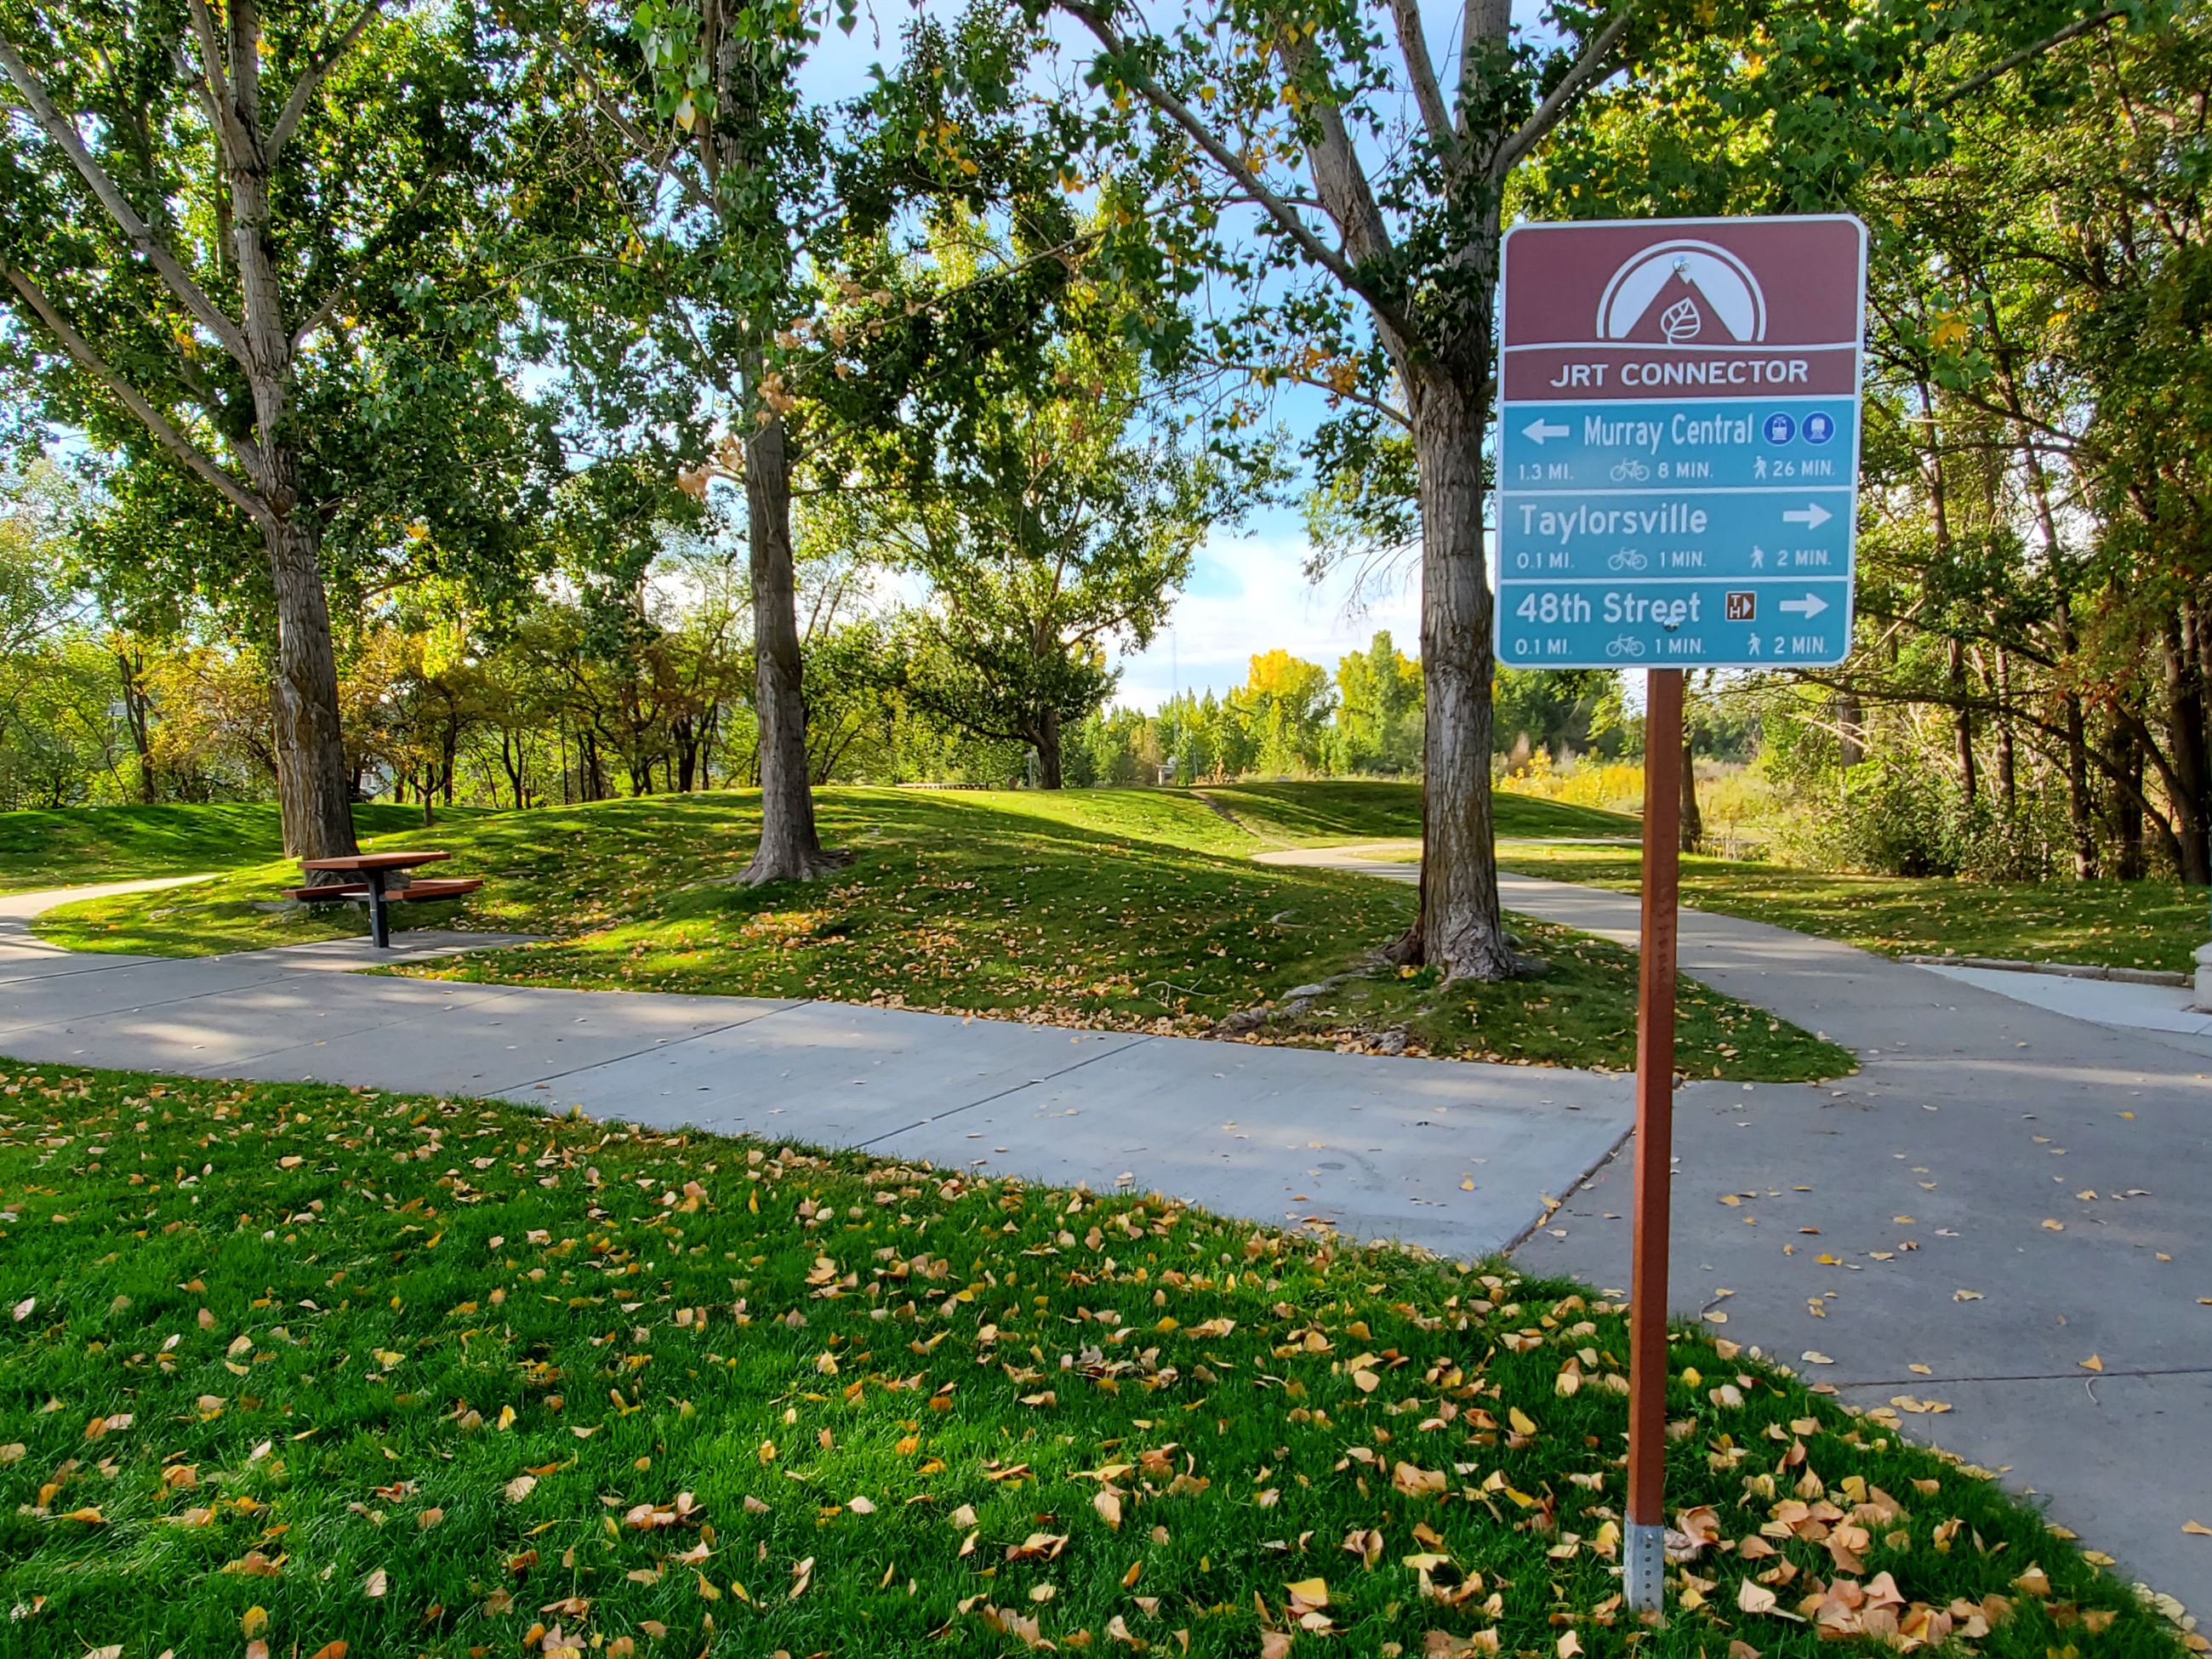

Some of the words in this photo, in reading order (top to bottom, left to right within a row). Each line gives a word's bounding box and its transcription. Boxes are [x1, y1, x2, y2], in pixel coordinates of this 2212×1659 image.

[1550, 363, 1609, 387] JRT
[1621, 360, 1809, 385] CONNECTOR
[1584, 415, 1663, 455] Murray
[1672, 413, 1753, 444] Central
[1518, 464, 1542, 482] 1.3
[1548, 465, 1574, 480] MI.
[1657, 463, 1669, 477] 8
[1676, 462, 1713, 477] MIN.
[1773, 460, 1795, 476] 26
[1801, 459, 1835, 476] MIN.
[1519, 503, 1707, 544] Taylorsville
[1516, 552, 1542, 569] 0.1
[1549, 552, 1575, 568] MI.
[1660, 551, 1666, 567] 1
[1672, 550, 1707, 567] MIN.
[1777, 550, 1787, 566] 2
[1795, 549, 1832, 566] MIN.
[1516, 592, 1591, 623] 48th
[1603, 591, 1701, 623] Street
[1514, 638, 1540, 655] 0.1
[1547, 638, 1572, 654] MI.
[1656, 638, 1662, 654] 1
[1668, 637, 1707, 654] MIN.
[1774, 637, 1784, 653] 2
[1792, 636, 1828, 653] MIN.
